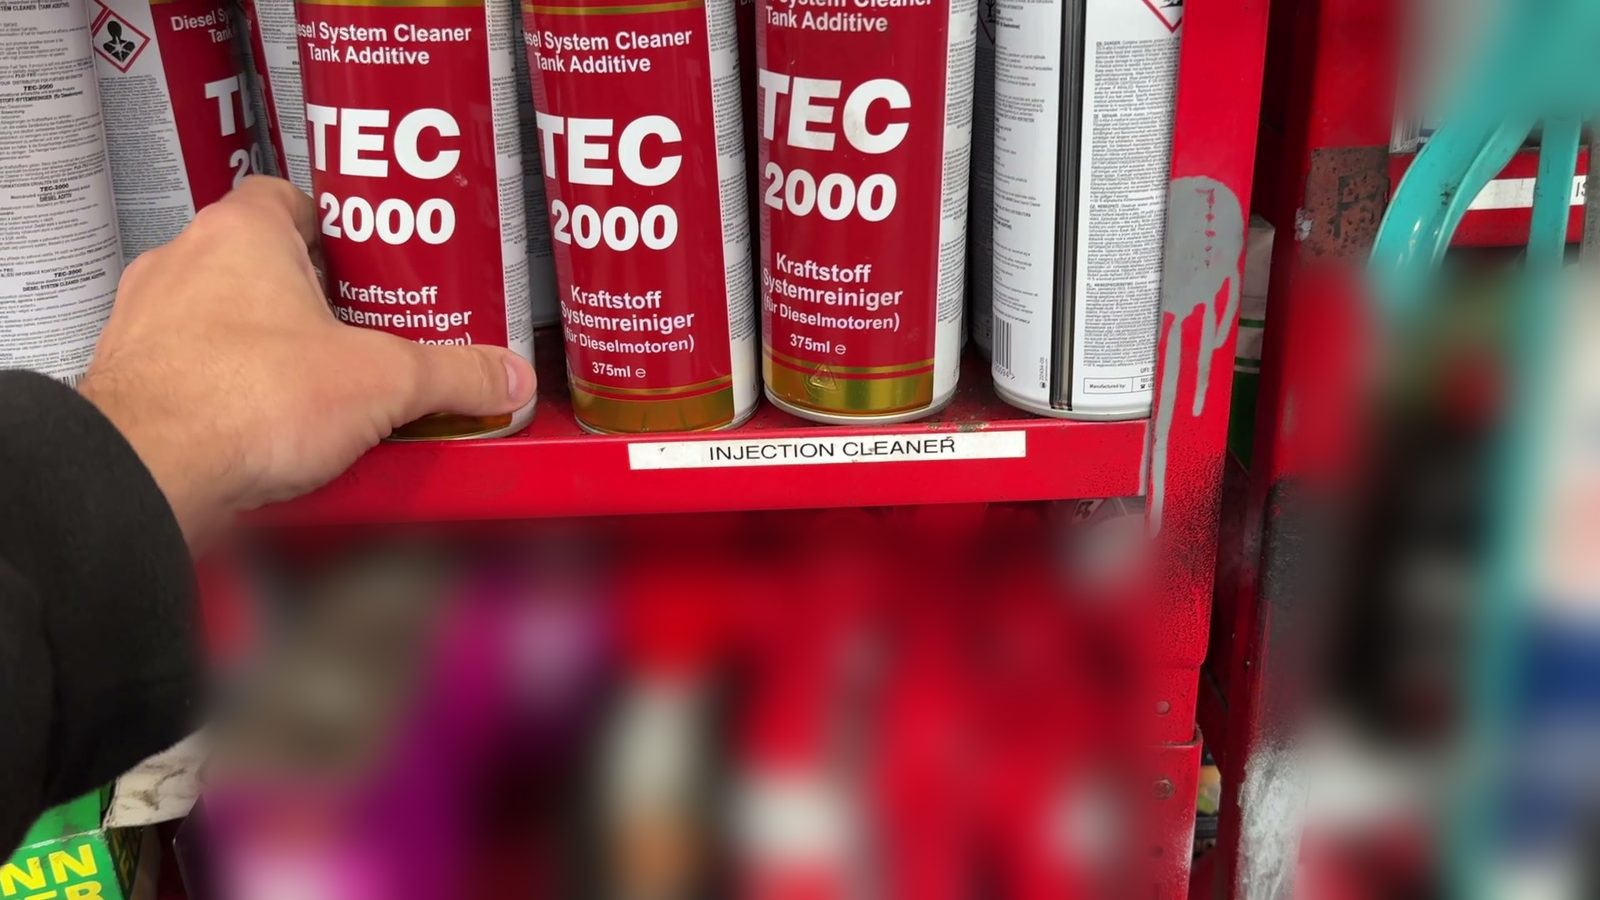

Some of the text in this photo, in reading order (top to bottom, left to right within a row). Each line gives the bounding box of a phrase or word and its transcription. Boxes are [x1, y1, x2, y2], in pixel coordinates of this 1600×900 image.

[171, 10, 216, 31] Diesel
[766, 6, 888, 32] Tank Additive
[319, 22, 387, 44] System
[394, 23, 472, 42] Cleaner
[545, 32, 609, 53] System
[615, 30, 692, 50] Cleaner
[307, 43, 430, 65] Tank Additive
[534, 52, 651, 73] Tank Additive
[759, 68, 912, 154] TEC
[306, 103, 461, 180] TEC
[535, 111, 683, 187] TEC
[40, 183, 69, 192] TEC-2000
[764, 161, 897, 222] 2000
[320, 191, 456, 245] 2000
[551, 199, 679, 252] 2000
[54, 268, 83, 278] TEC-2000
[776, 252, 872, 283] Kraftstoff
[339, 280, 438, 305] Kraftstoff
[570, 285, 662, 310] Kraftstoff
[763, 267, 903, 312] Systemreiniger
[334, 305, 472, 332] ystemreiniger
[560, 300, 695, 335] Systemreiniger
[779, 303, 901, 332] Dieselmotoren)
[579, 334, 696, 353] Dieselmotoren)
[790, 333, 831, 354] 375ml
[592, 362, 631, 378] 375ml
[709, 438, 956, 461] INJECTION CLEANER
